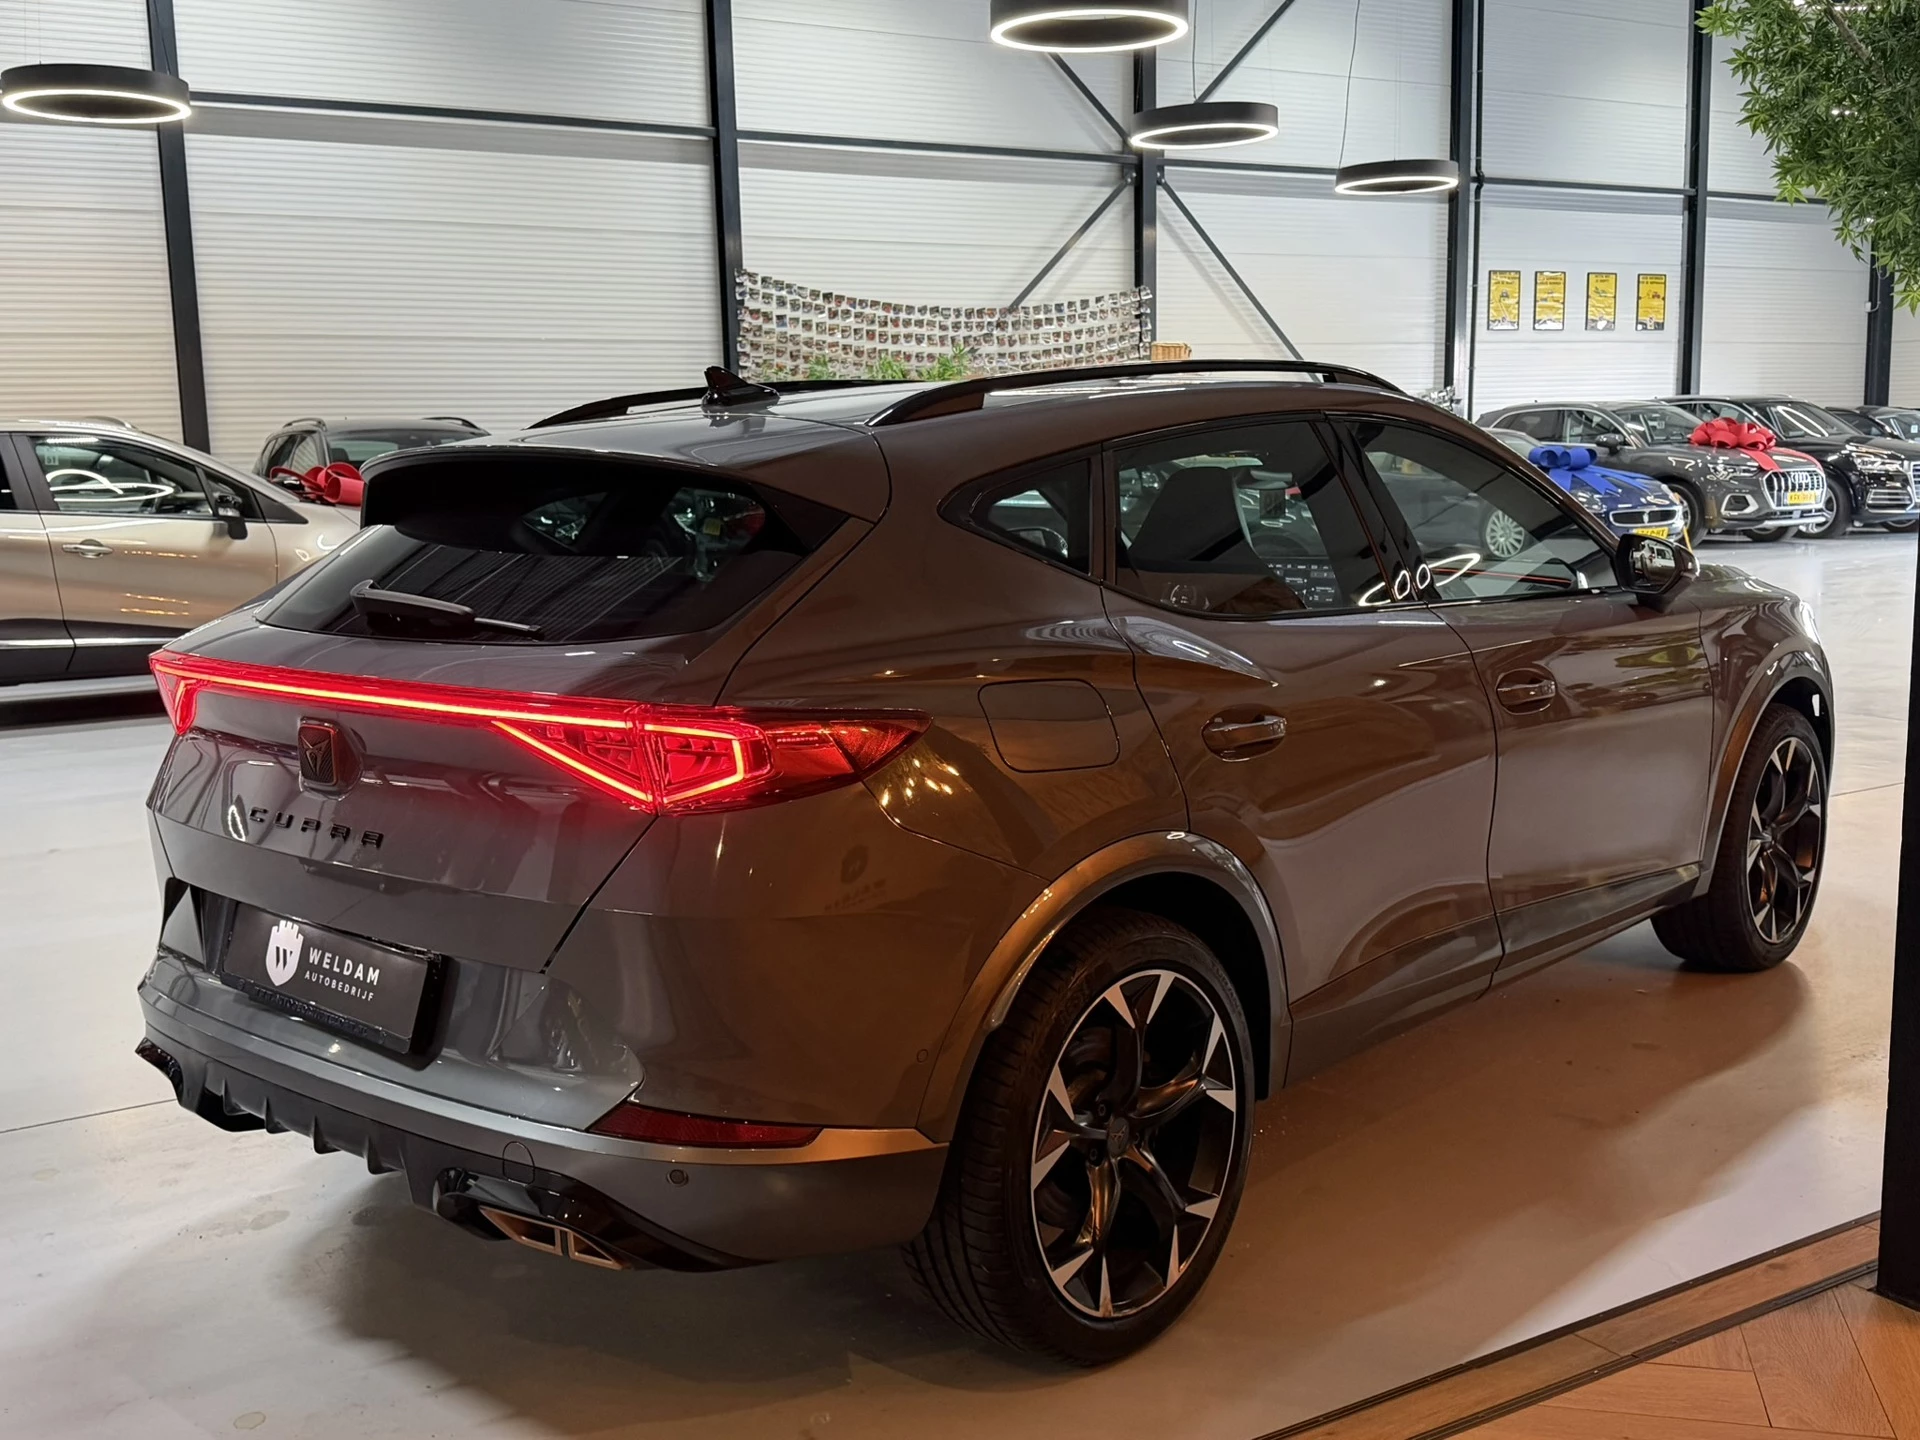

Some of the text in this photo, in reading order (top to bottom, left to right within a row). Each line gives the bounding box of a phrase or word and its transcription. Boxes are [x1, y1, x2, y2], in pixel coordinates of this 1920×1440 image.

[249, 807, 384, 849] CUPRA
[275, 945, 293, 971] W
[308, 946, 380, 986] WELDAM
[304, 970, 375, 1002] AUTOBEDRIJF
